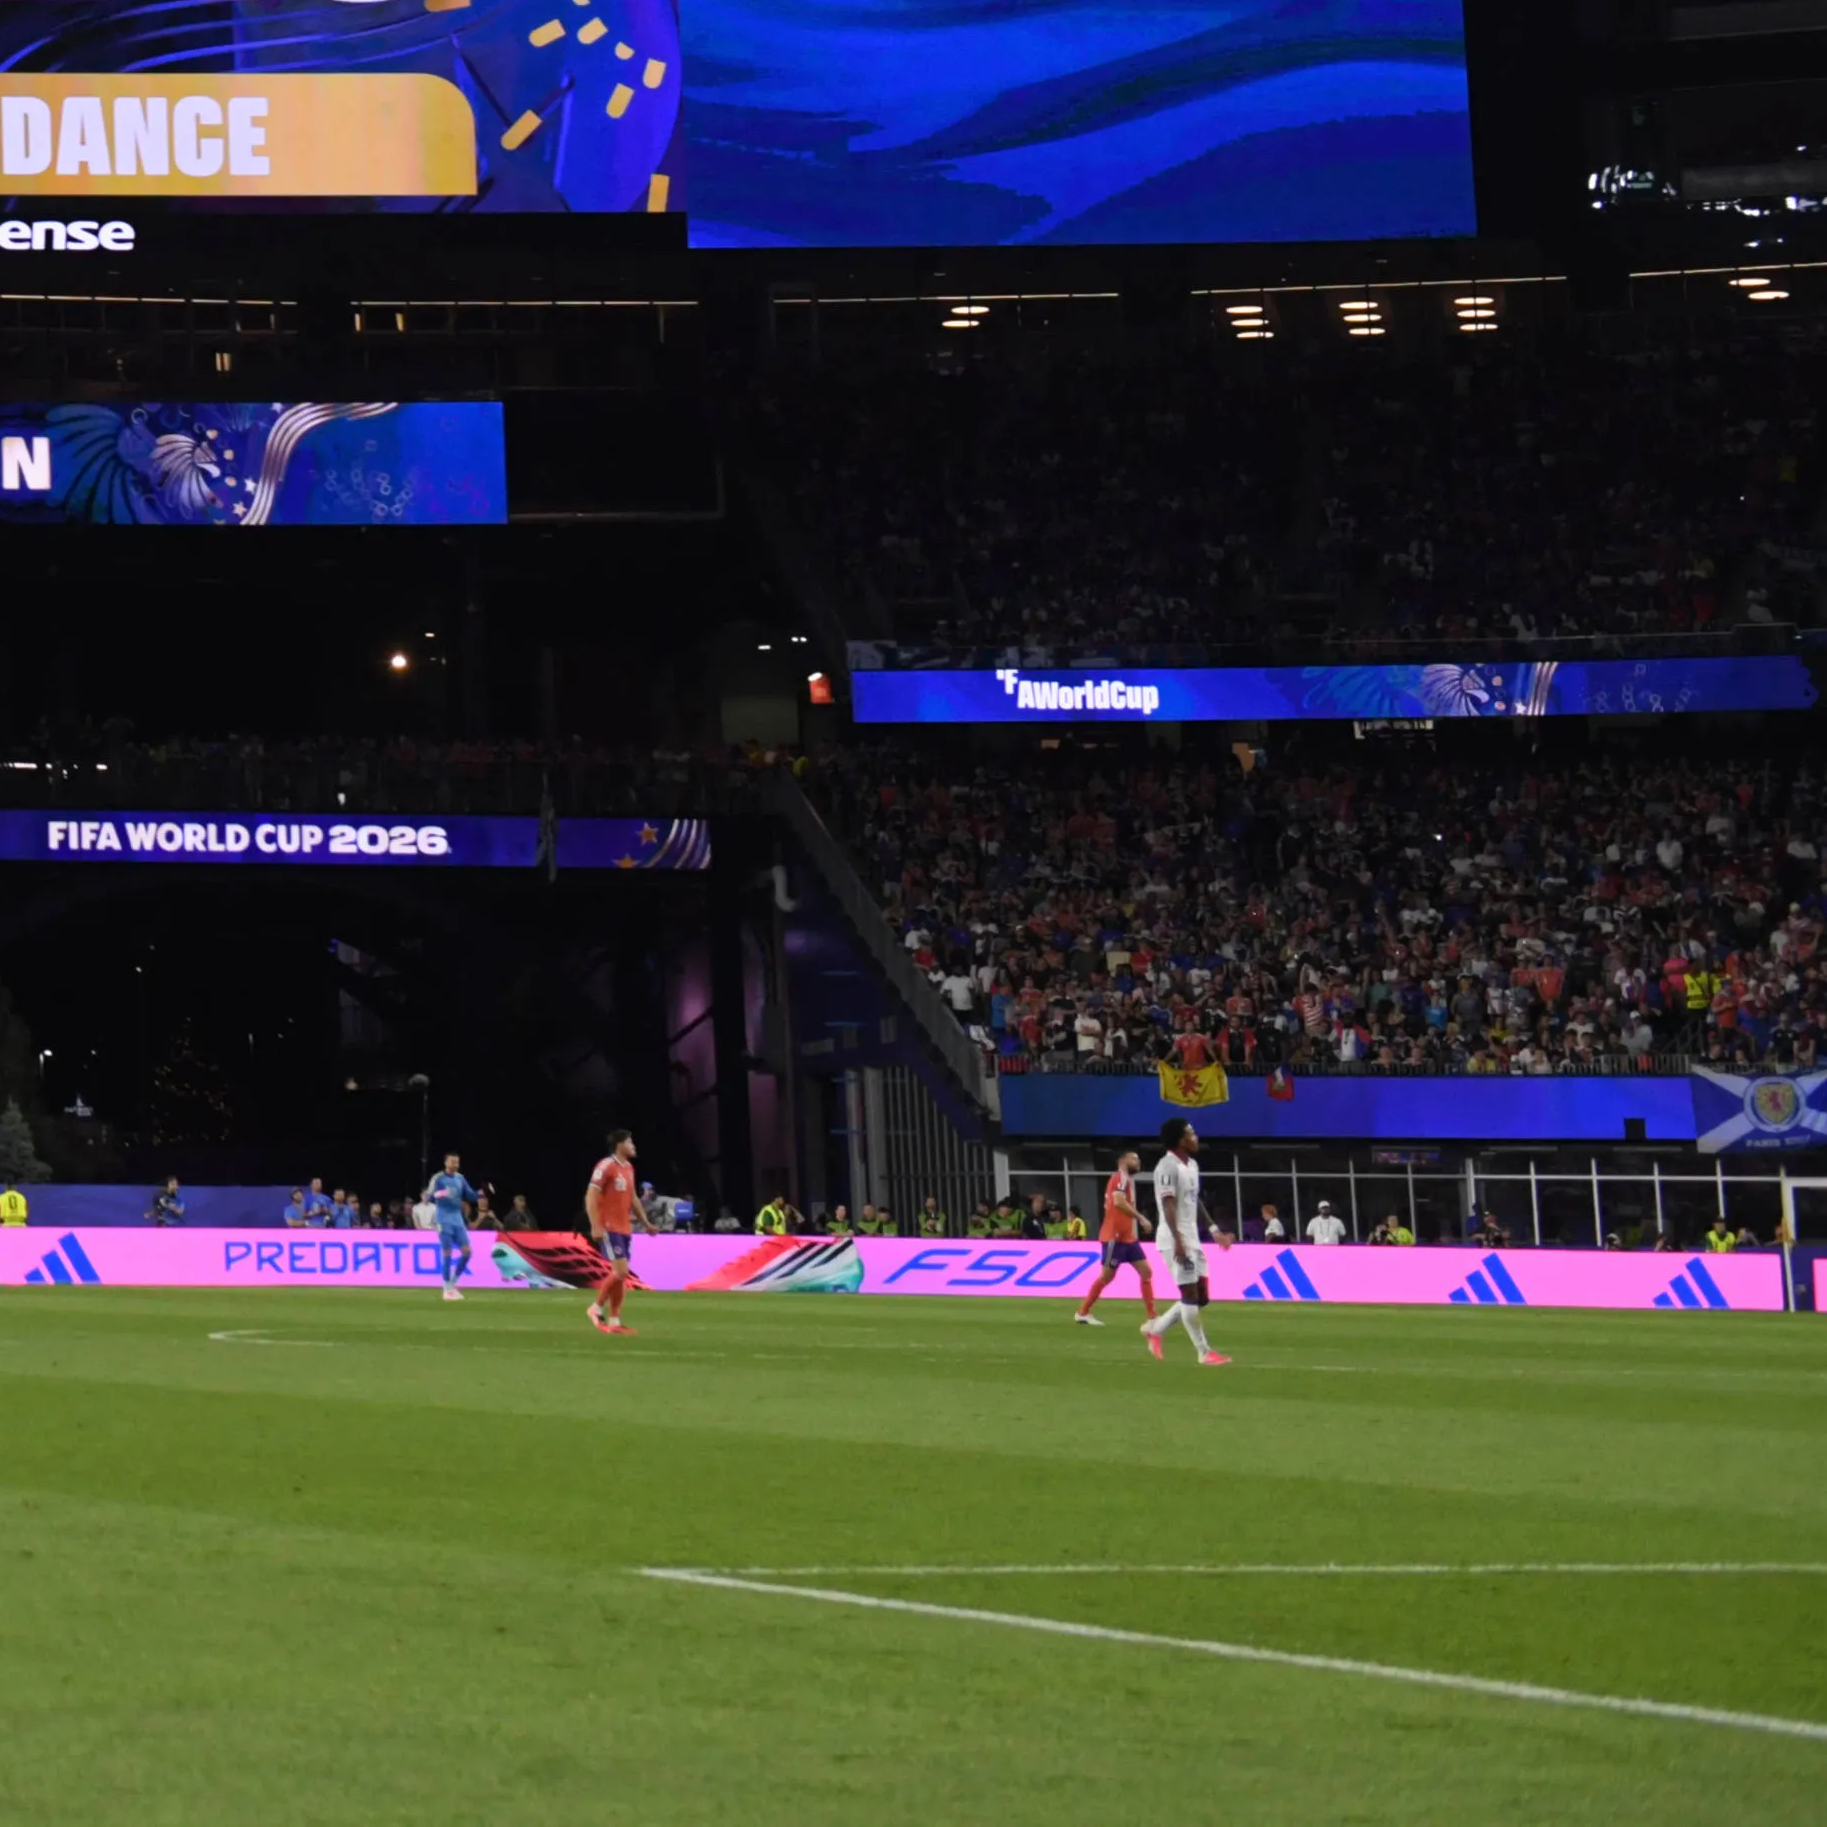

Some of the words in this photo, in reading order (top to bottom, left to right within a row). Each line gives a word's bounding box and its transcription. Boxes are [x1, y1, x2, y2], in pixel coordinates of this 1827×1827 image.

[48, 821, 122, 851] FIFA
[125, 822, 250, 852] WORLD
[255, 823, 324, 853] CUP
[328, 824, 450, 856] 2026
[883, 1248, 1100, 1287] F50
